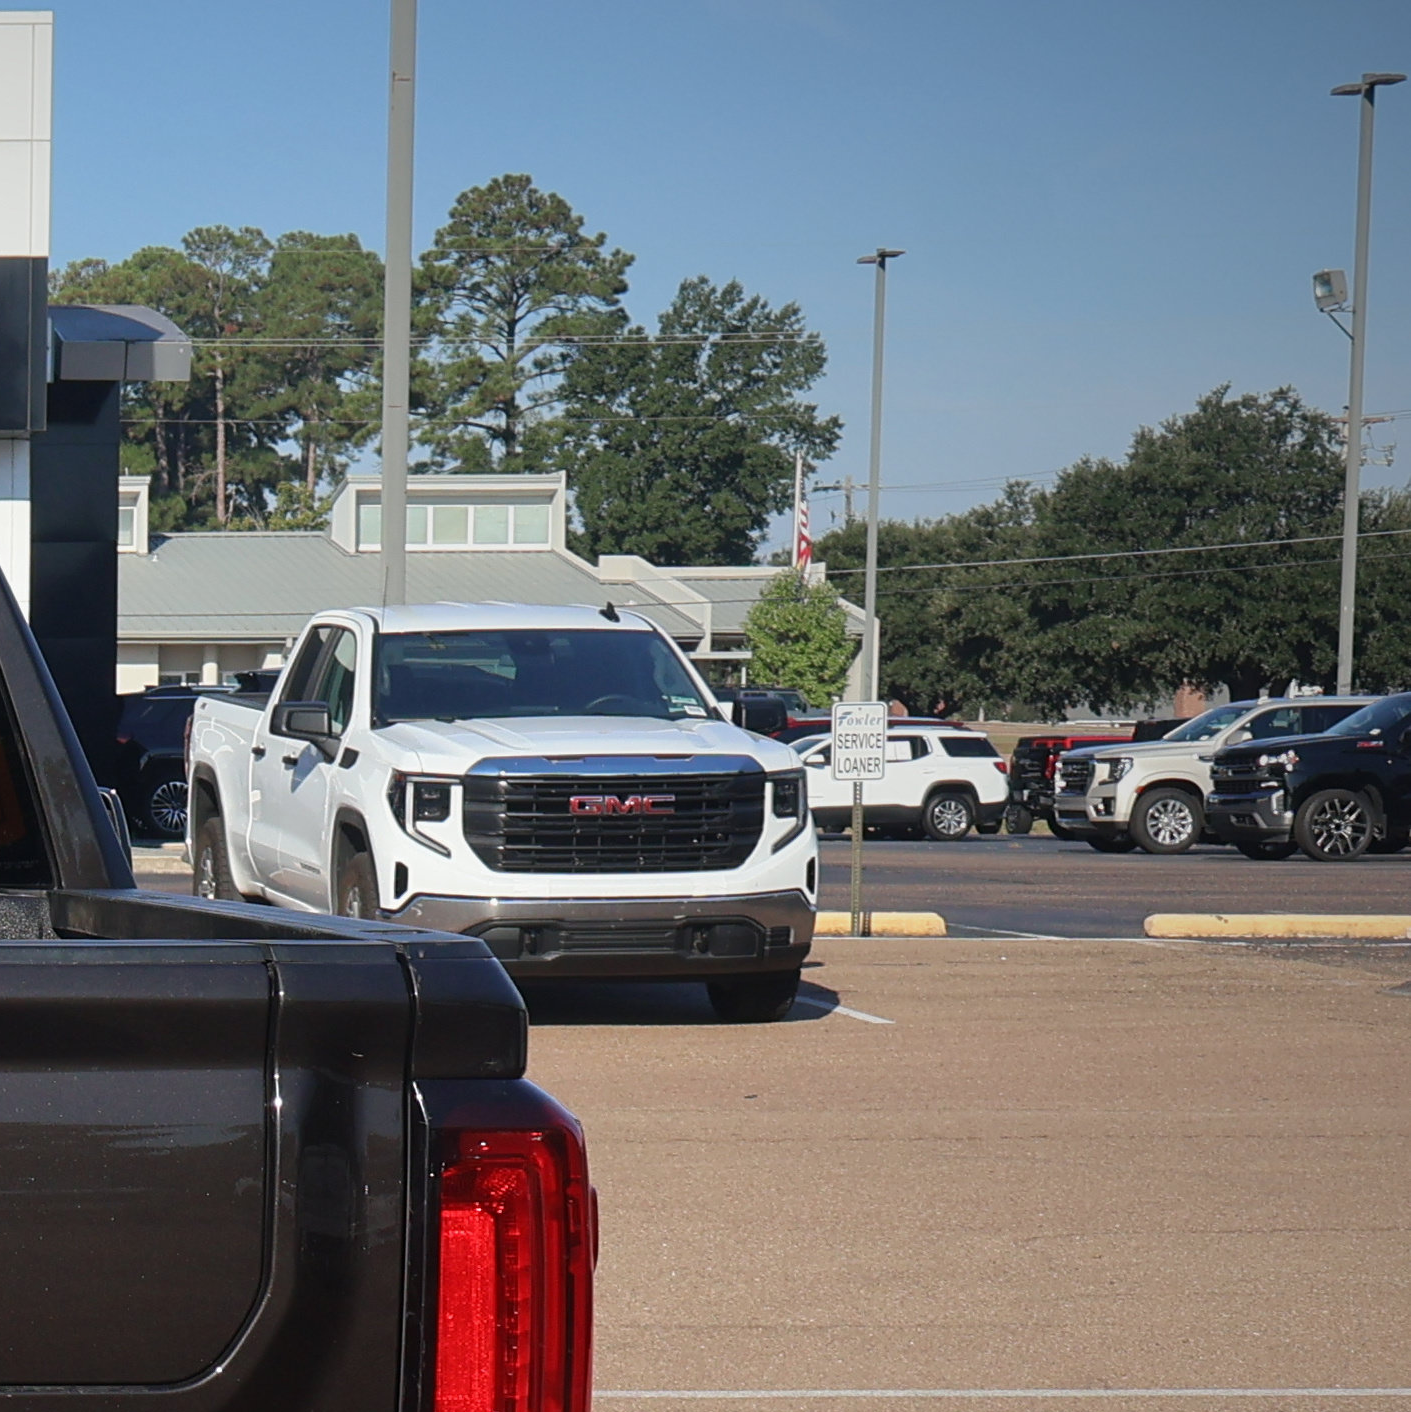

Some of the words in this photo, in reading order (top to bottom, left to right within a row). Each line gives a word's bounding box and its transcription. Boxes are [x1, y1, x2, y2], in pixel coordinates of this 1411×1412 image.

[838, 711, 883, 727] Fowler
[837, 733, 882, 749] SERVICE
[837, 757, 881, 773] LOANER
[570, 795, 675, 815] GMC
